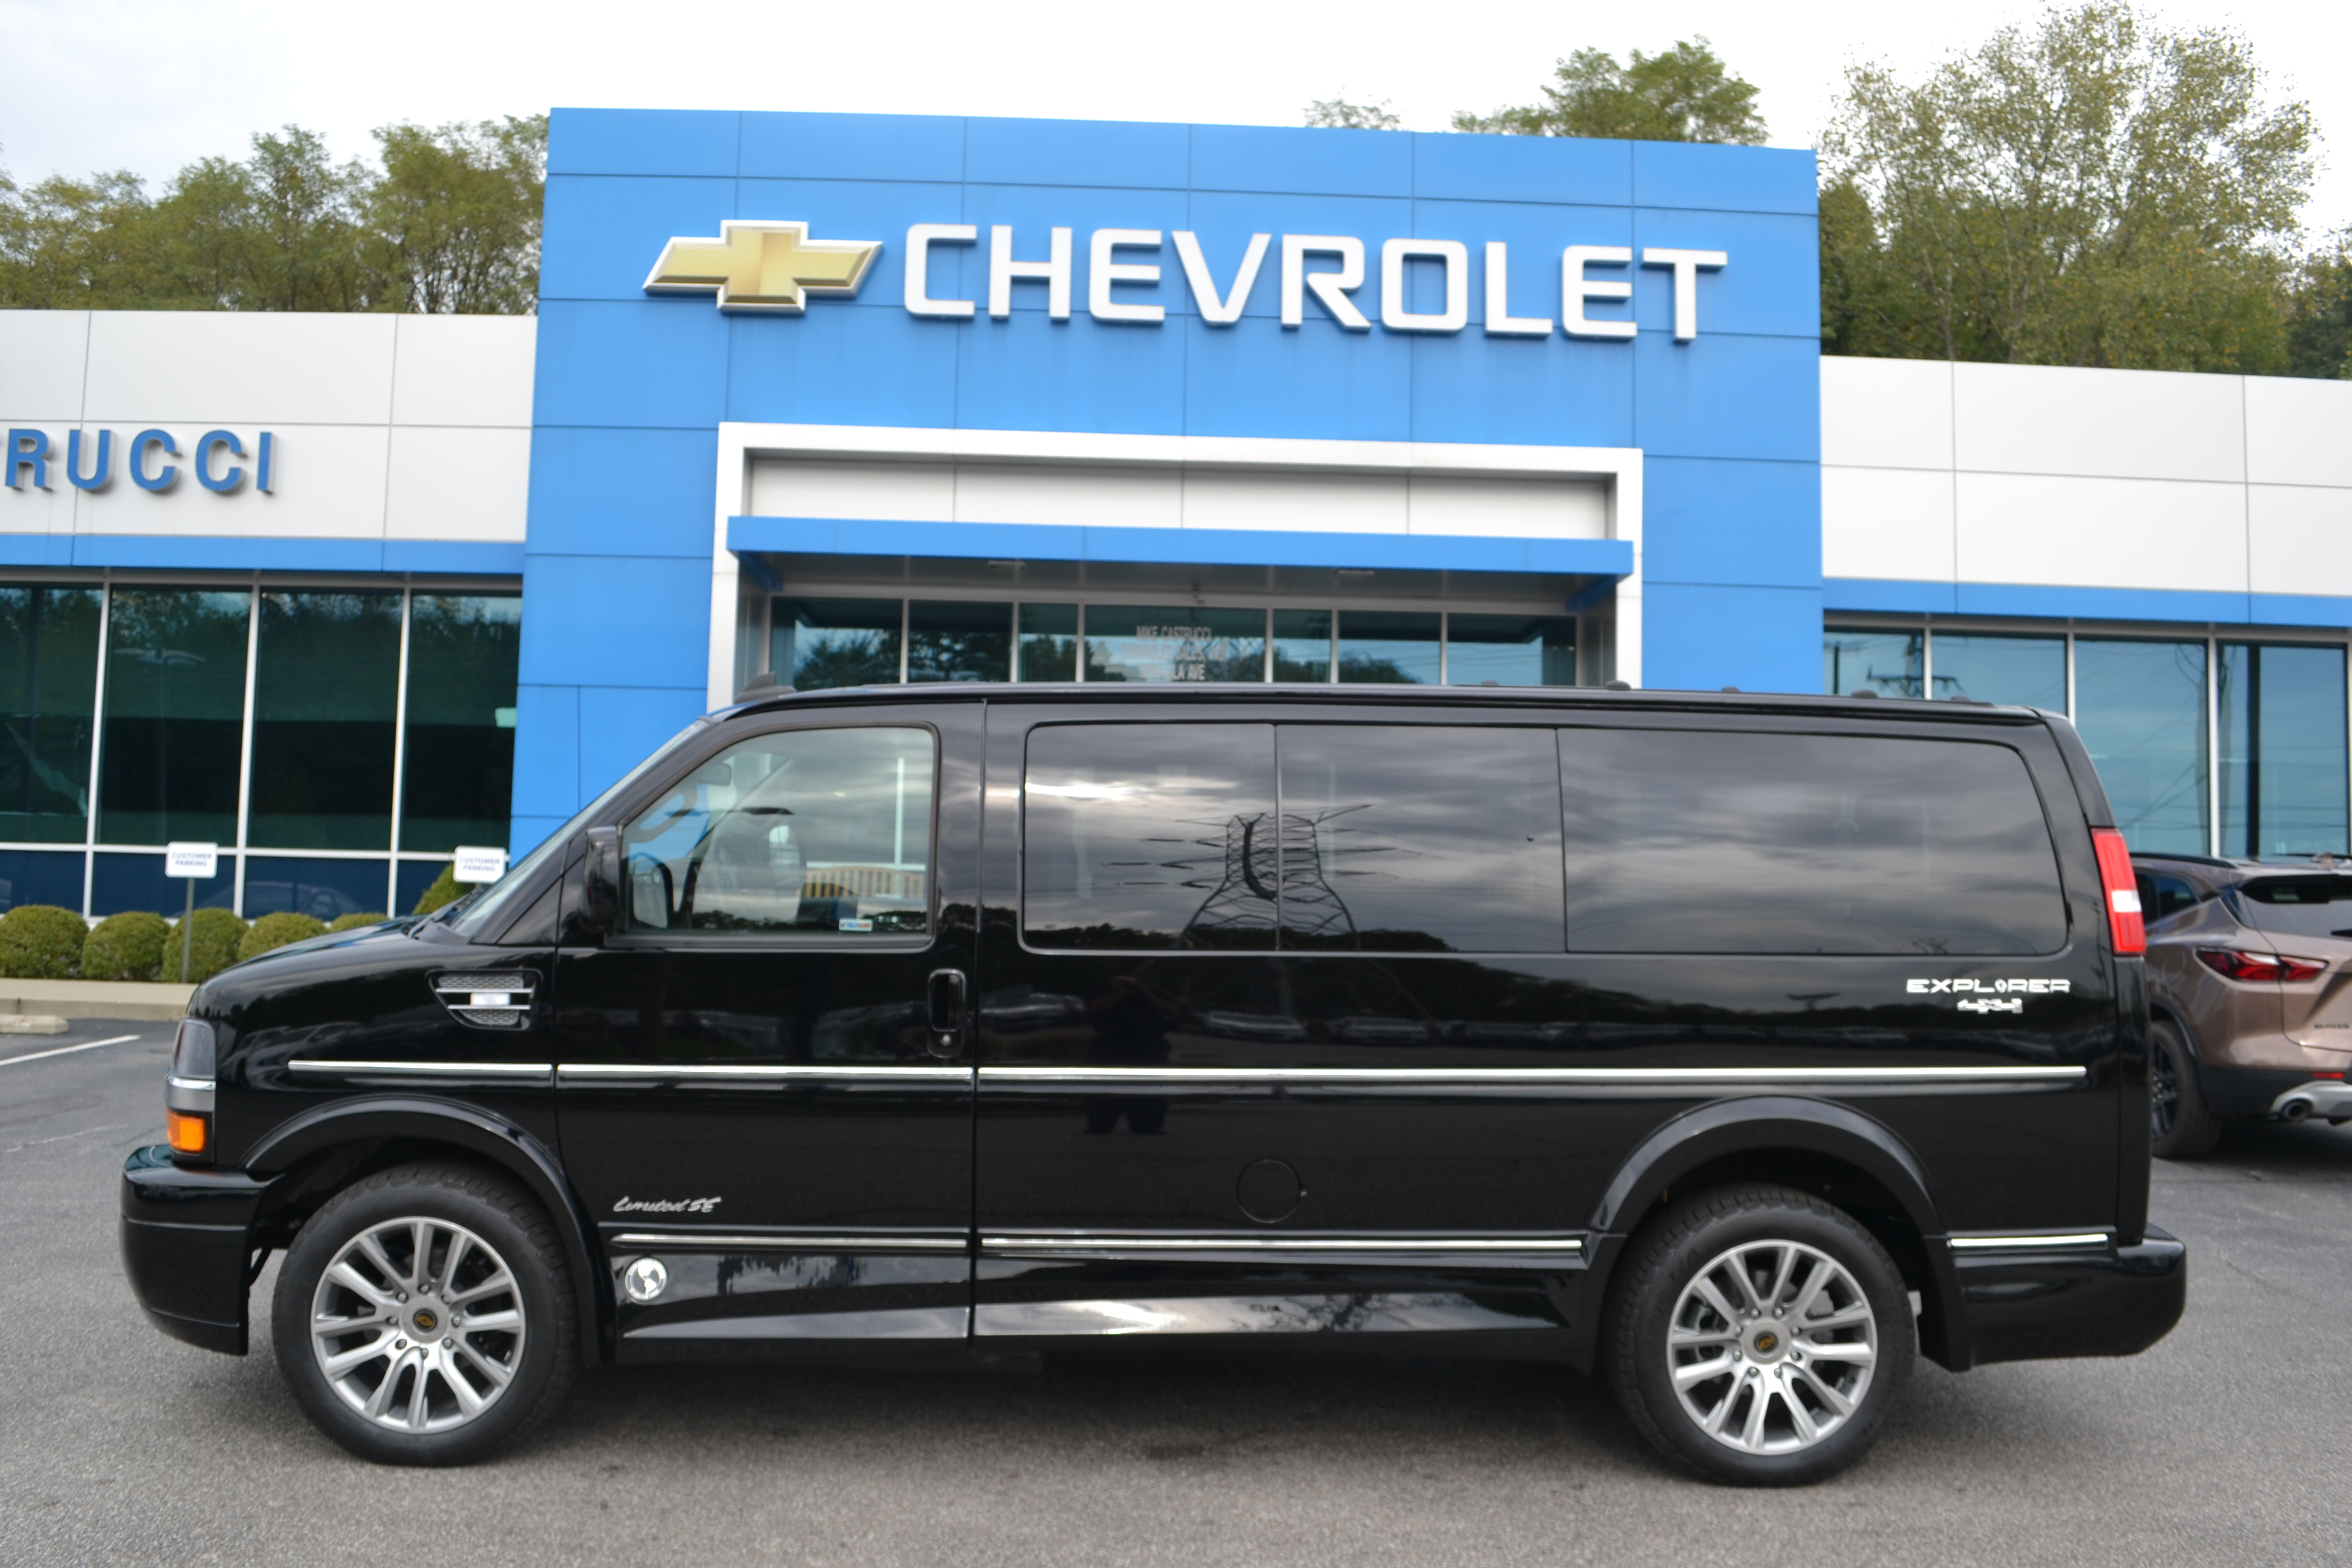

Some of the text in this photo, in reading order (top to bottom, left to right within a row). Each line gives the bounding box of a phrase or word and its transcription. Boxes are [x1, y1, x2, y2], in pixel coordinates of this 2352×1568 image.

[904, 223, 1728, 340] CHEVROLET
[5, 428, 274, 493] RUCCI
[1136, 625, 1212, 642] MIKE CASTRUCCI
[462, 864, 496, 872] PARKING
[1906, 978, 2071, 994] EXPLORER
